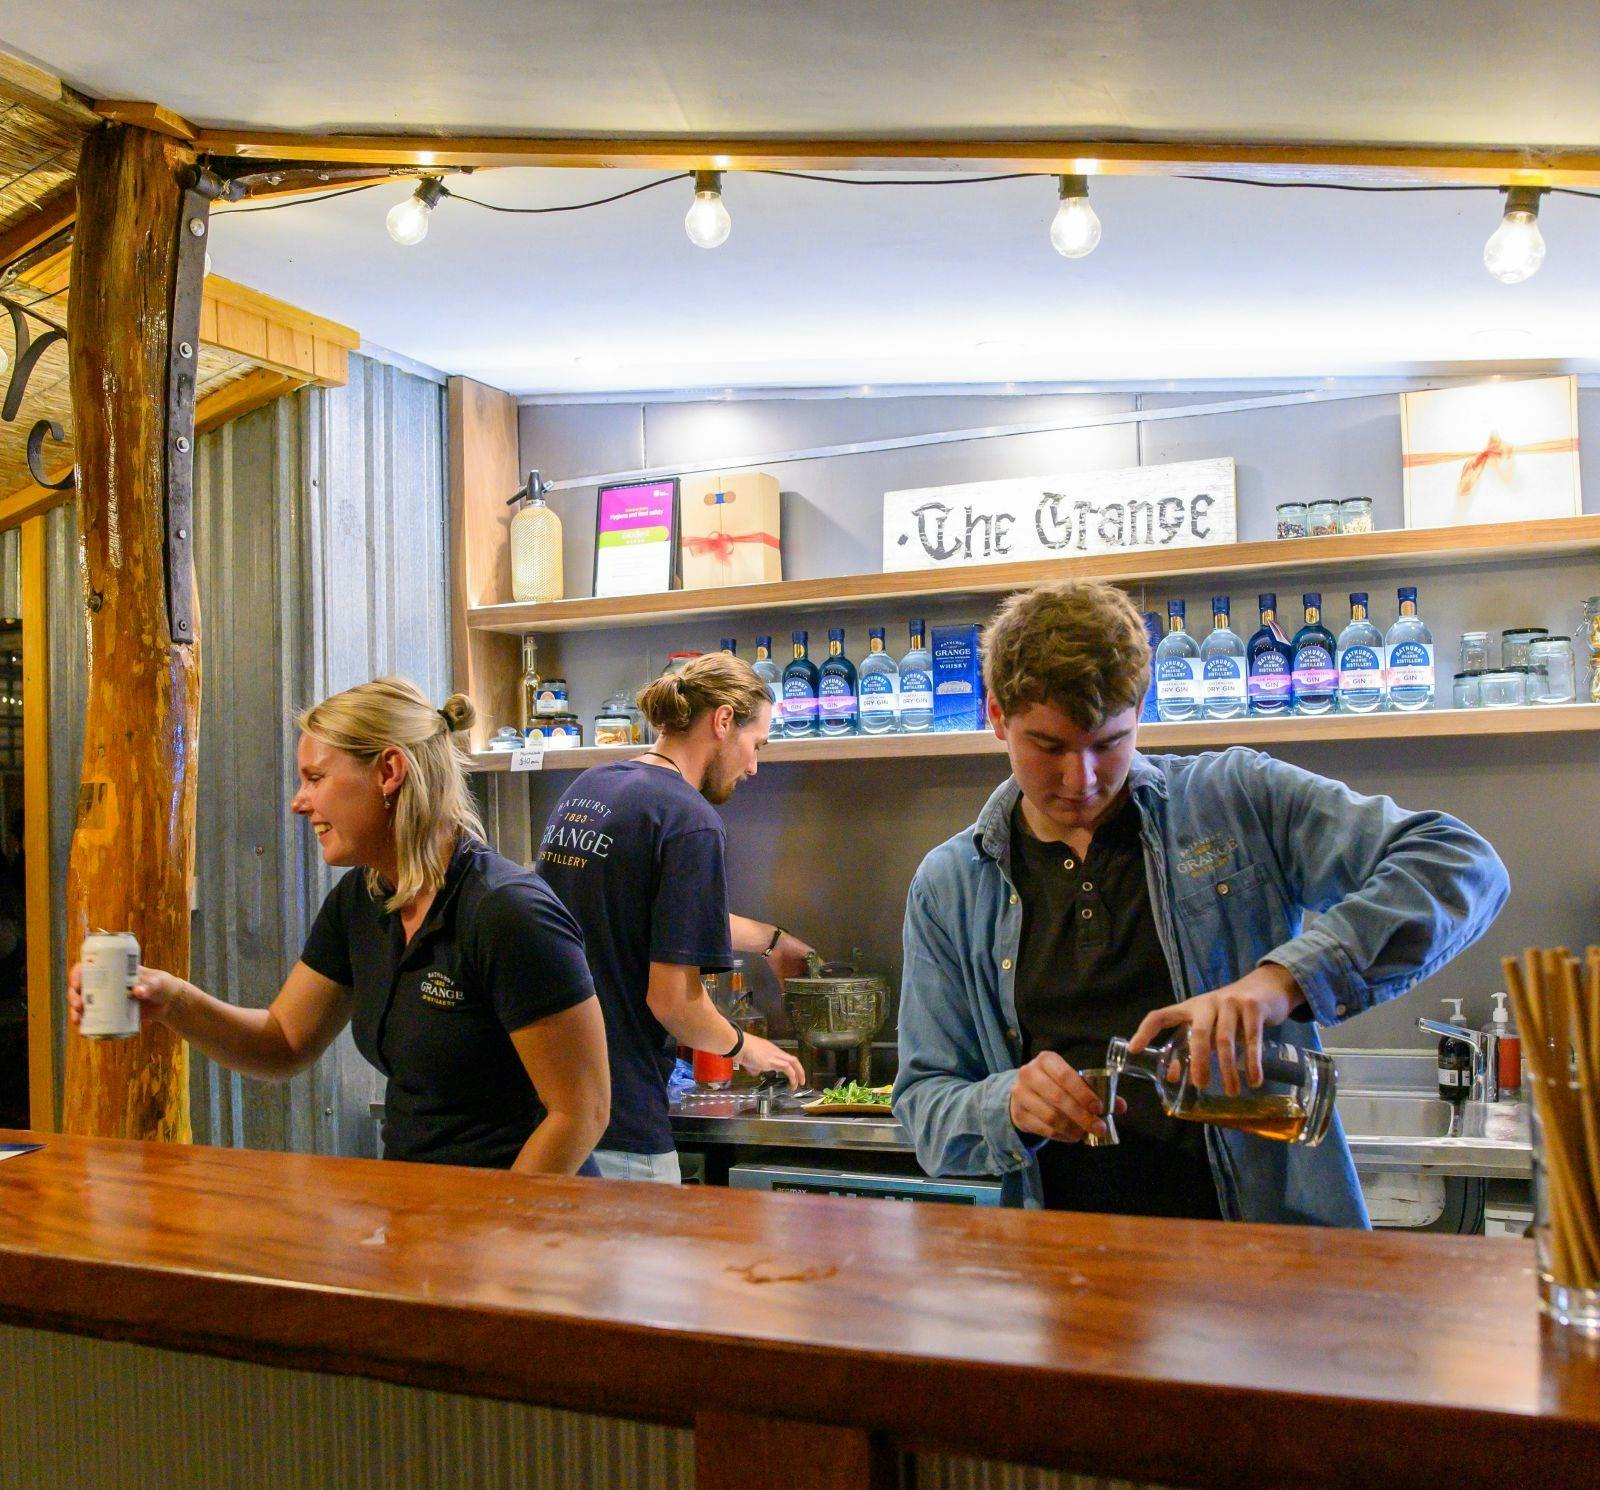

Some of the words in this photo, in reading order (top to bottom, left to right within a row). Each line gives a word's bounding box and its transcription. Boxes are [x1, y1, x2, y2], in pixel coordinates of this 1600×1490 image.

[911, 502, 1016, 561] The
[1034, 492, 1216, 551] Grange
[935, 648, 971, 657] GRANGE
[1299, 649, 1327, 660] BATHURST
[1345, 649, 1374, 661] BATHURST
[1395, 645, 1425, 656] BATHURST
[1257, 654, 1285, 666] BATHURST
[420, 981, 465, 1000] GRANGE
